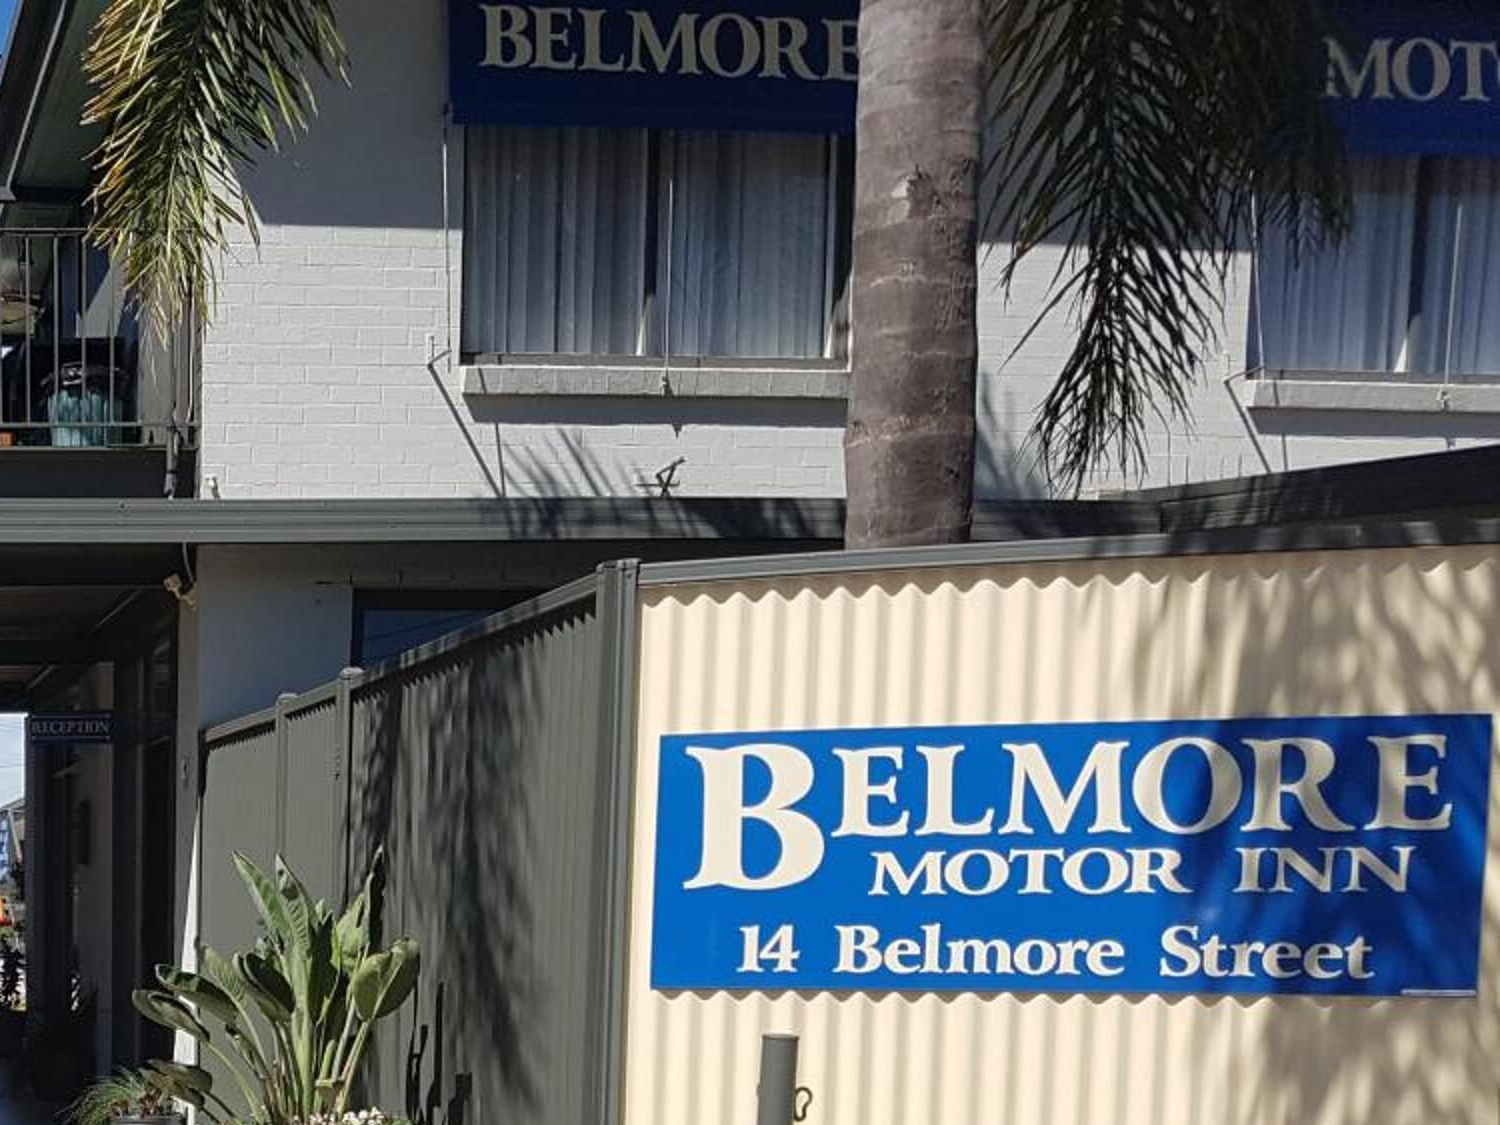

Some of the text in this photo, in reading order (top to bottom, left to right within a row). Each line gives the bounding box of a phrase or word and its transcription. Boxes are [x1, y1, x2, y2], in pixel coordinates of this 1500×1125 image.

[478, 3, 859, 83] BELMORE
[1320, 34, 1500, 103] MOT
[682, 733, 1456, 892] BELMORE
[868, 844, 1415, 897] MOTOR INN
[737, 923, 1376, 981] 14 Belmore Street
